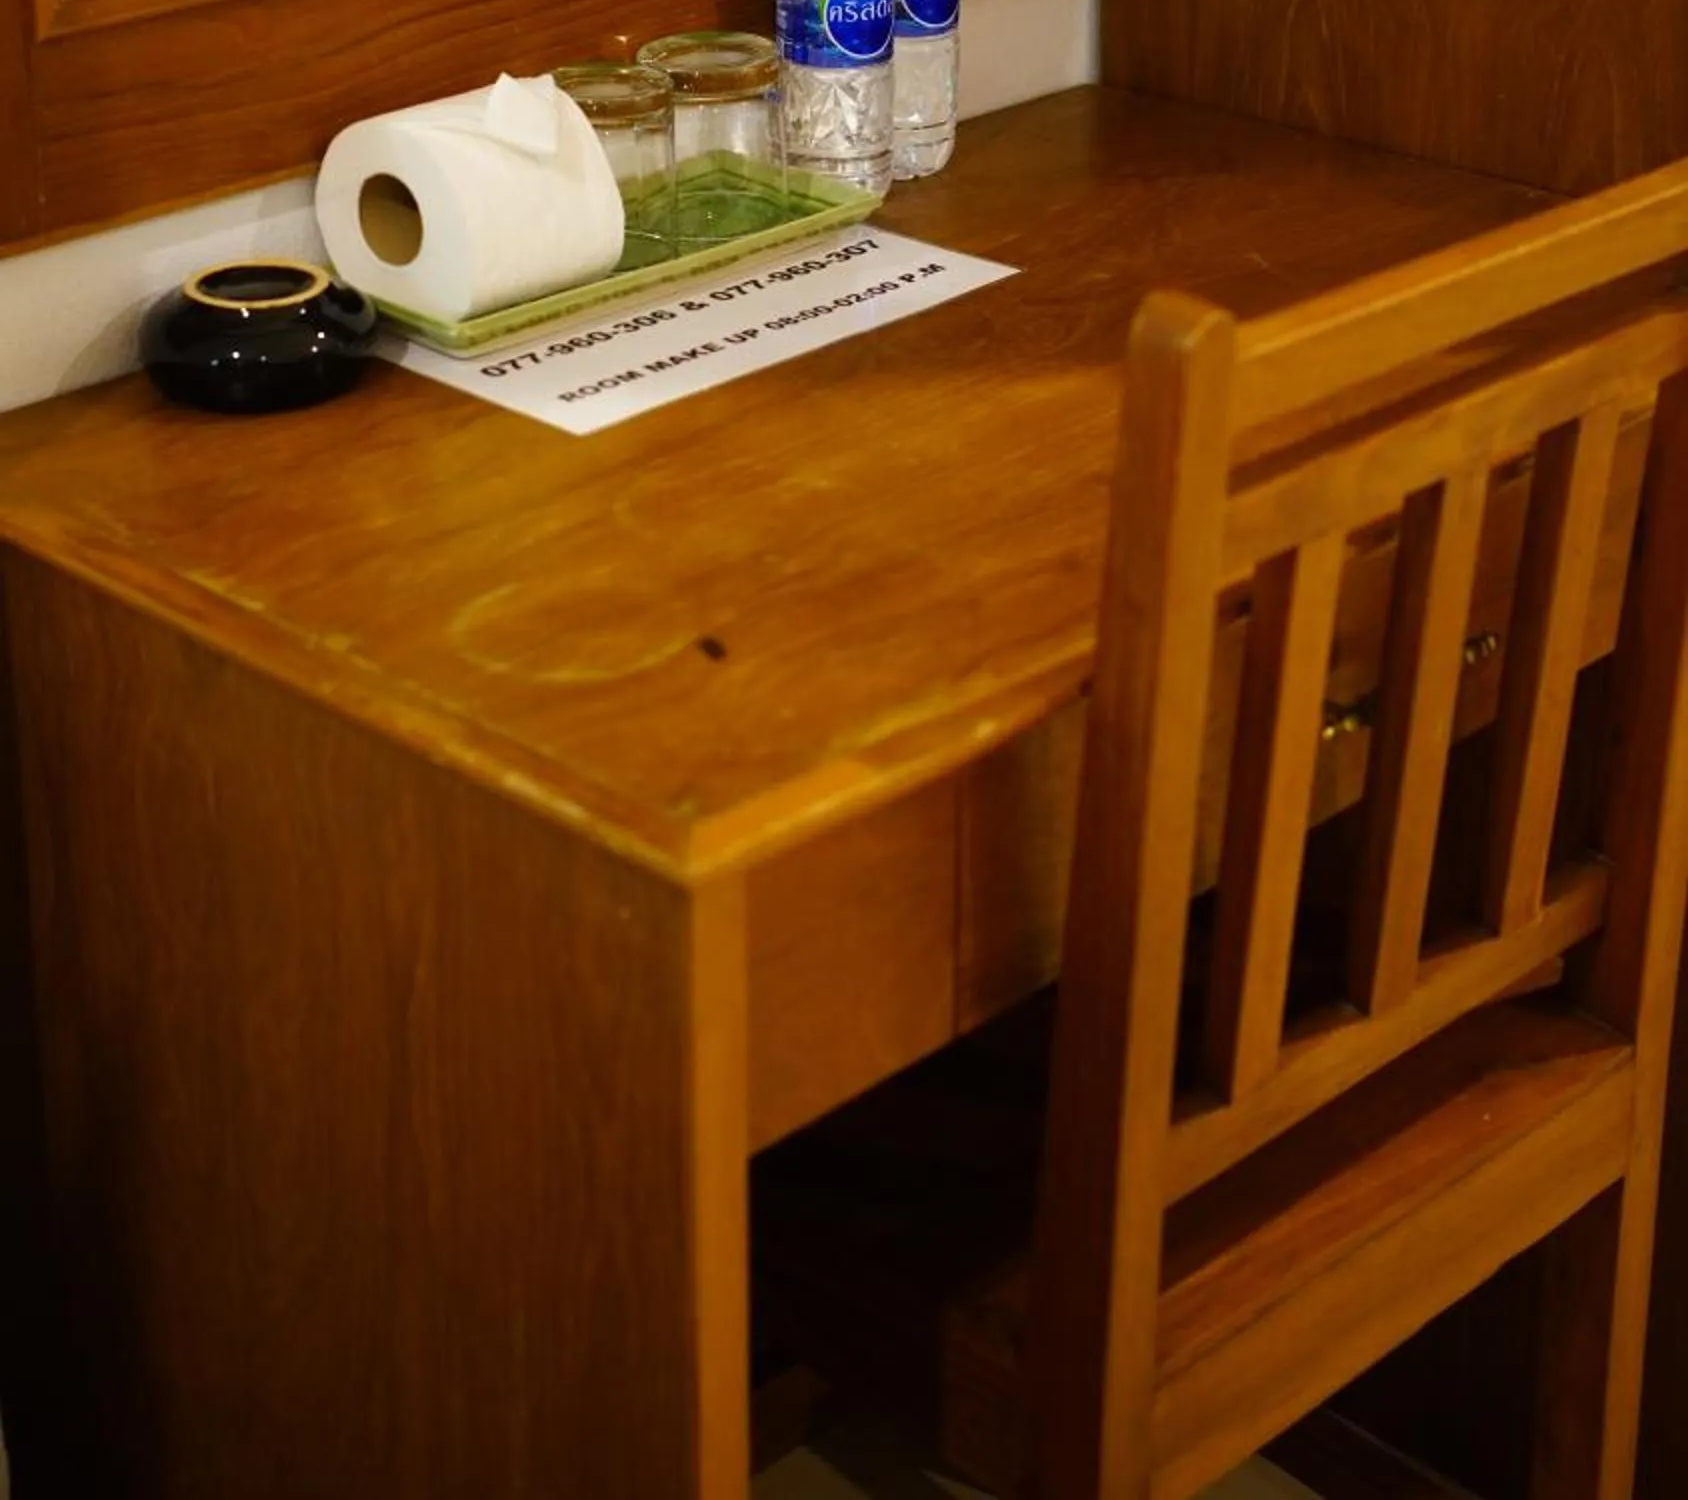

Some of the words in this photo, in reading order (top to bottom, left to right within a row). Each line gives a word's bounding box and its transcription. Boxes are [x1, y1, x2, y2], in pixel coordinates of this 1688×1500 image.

[480, 309, 677, 378] 077-960-306
[679, 300, 710, 312] &
[709, 239, 880, 302] 077-960-307
[557, 370, 644, 403] ROOM
[645, 343, 726, 373] MAKE
[724, 328, 760, 345] UP
[764, 281, 899, 331] 08:00-02:00
